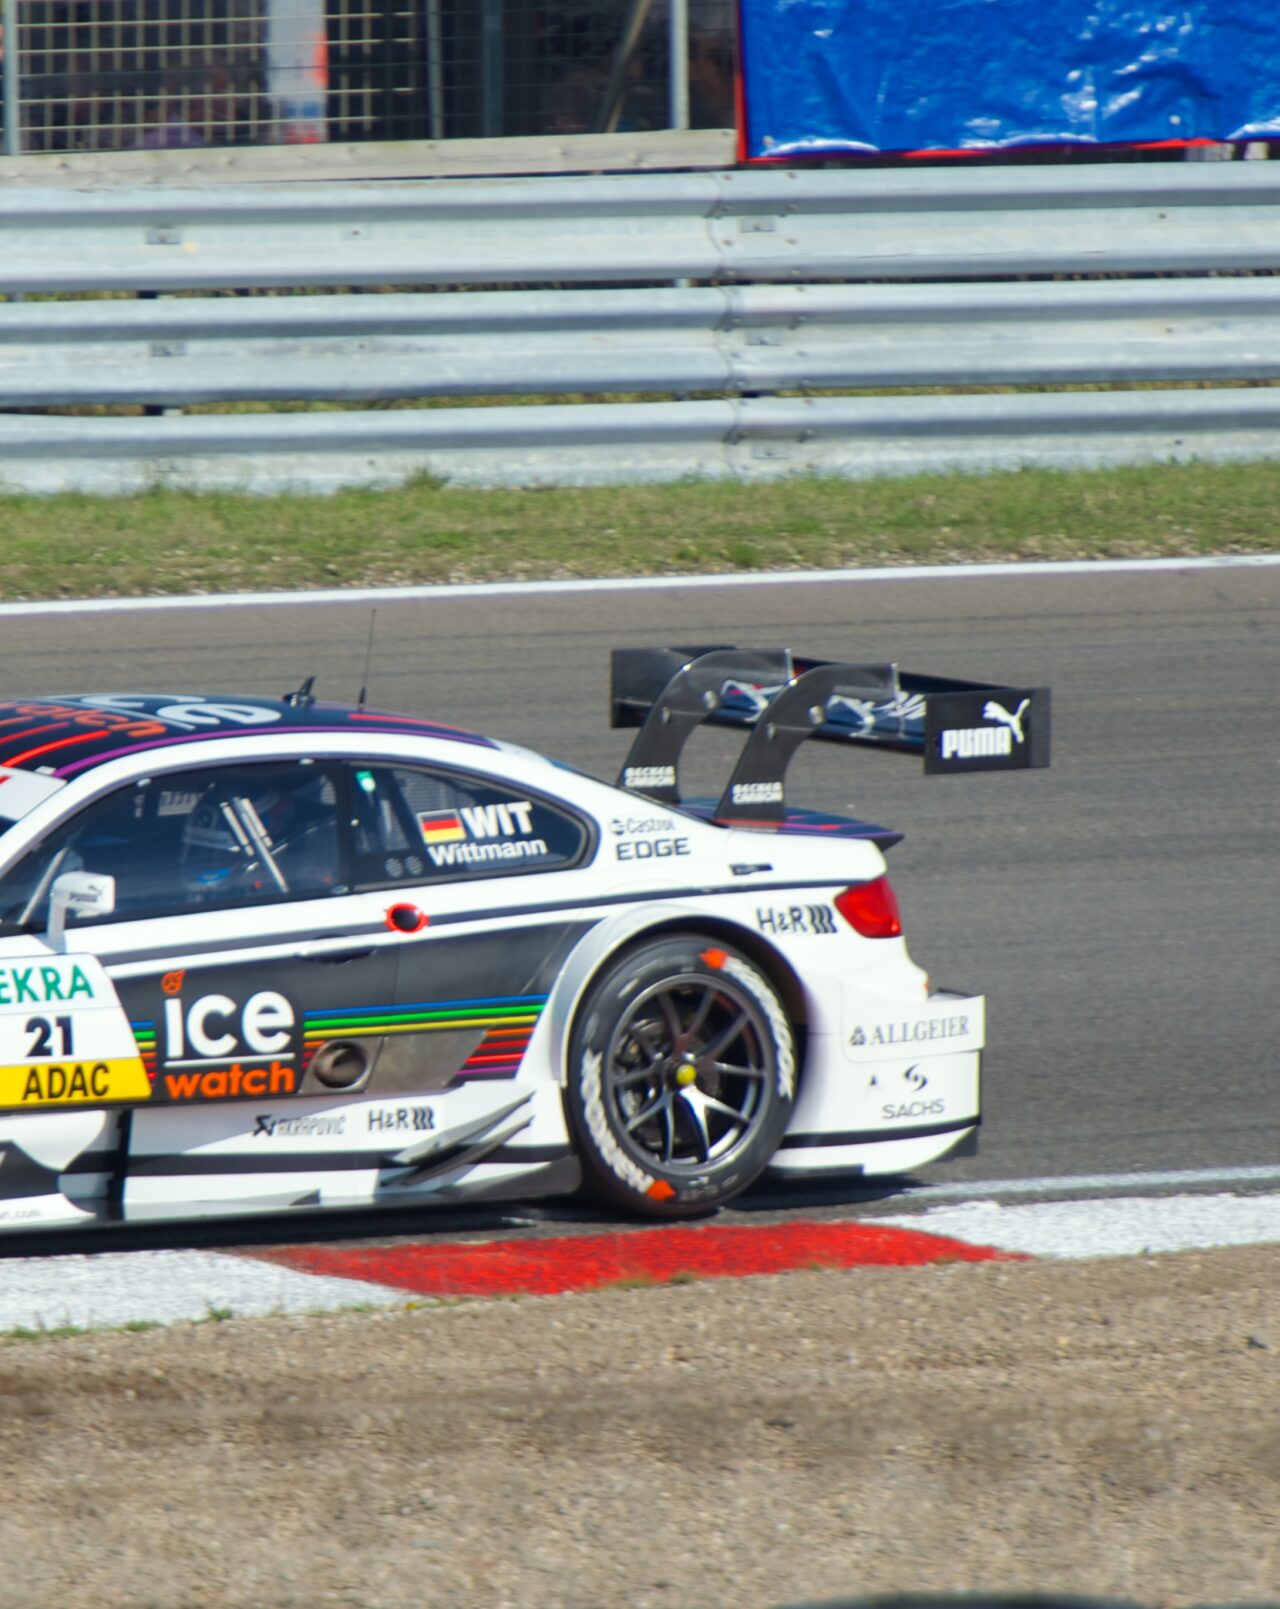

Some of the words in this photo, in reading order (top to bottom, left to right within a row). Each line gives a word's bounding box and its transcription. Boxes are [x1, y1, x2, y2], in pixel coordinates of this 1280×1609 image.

[941, 727, 1012, 759] PUMA
[460, 801, 533, 839] WIT
[626, 818, 677, 834] Castrol
[427, 839, 548, 867] Wittmann
[616, 837, 692, 861] EDGE
[756, 905, 808, 933] H&R
[161, 970, 295, 1058] ice
[24, 1015, 74, 1058] 21
[869, 1015, 970, 1046] ALLGEIER
[22, 1062, 111, 1101] ADAC
[164, 1061, 296, 1099] watch
[368, 1108, 409, 1131] H&R
[881, 1098, 946, 1120] SACHS
